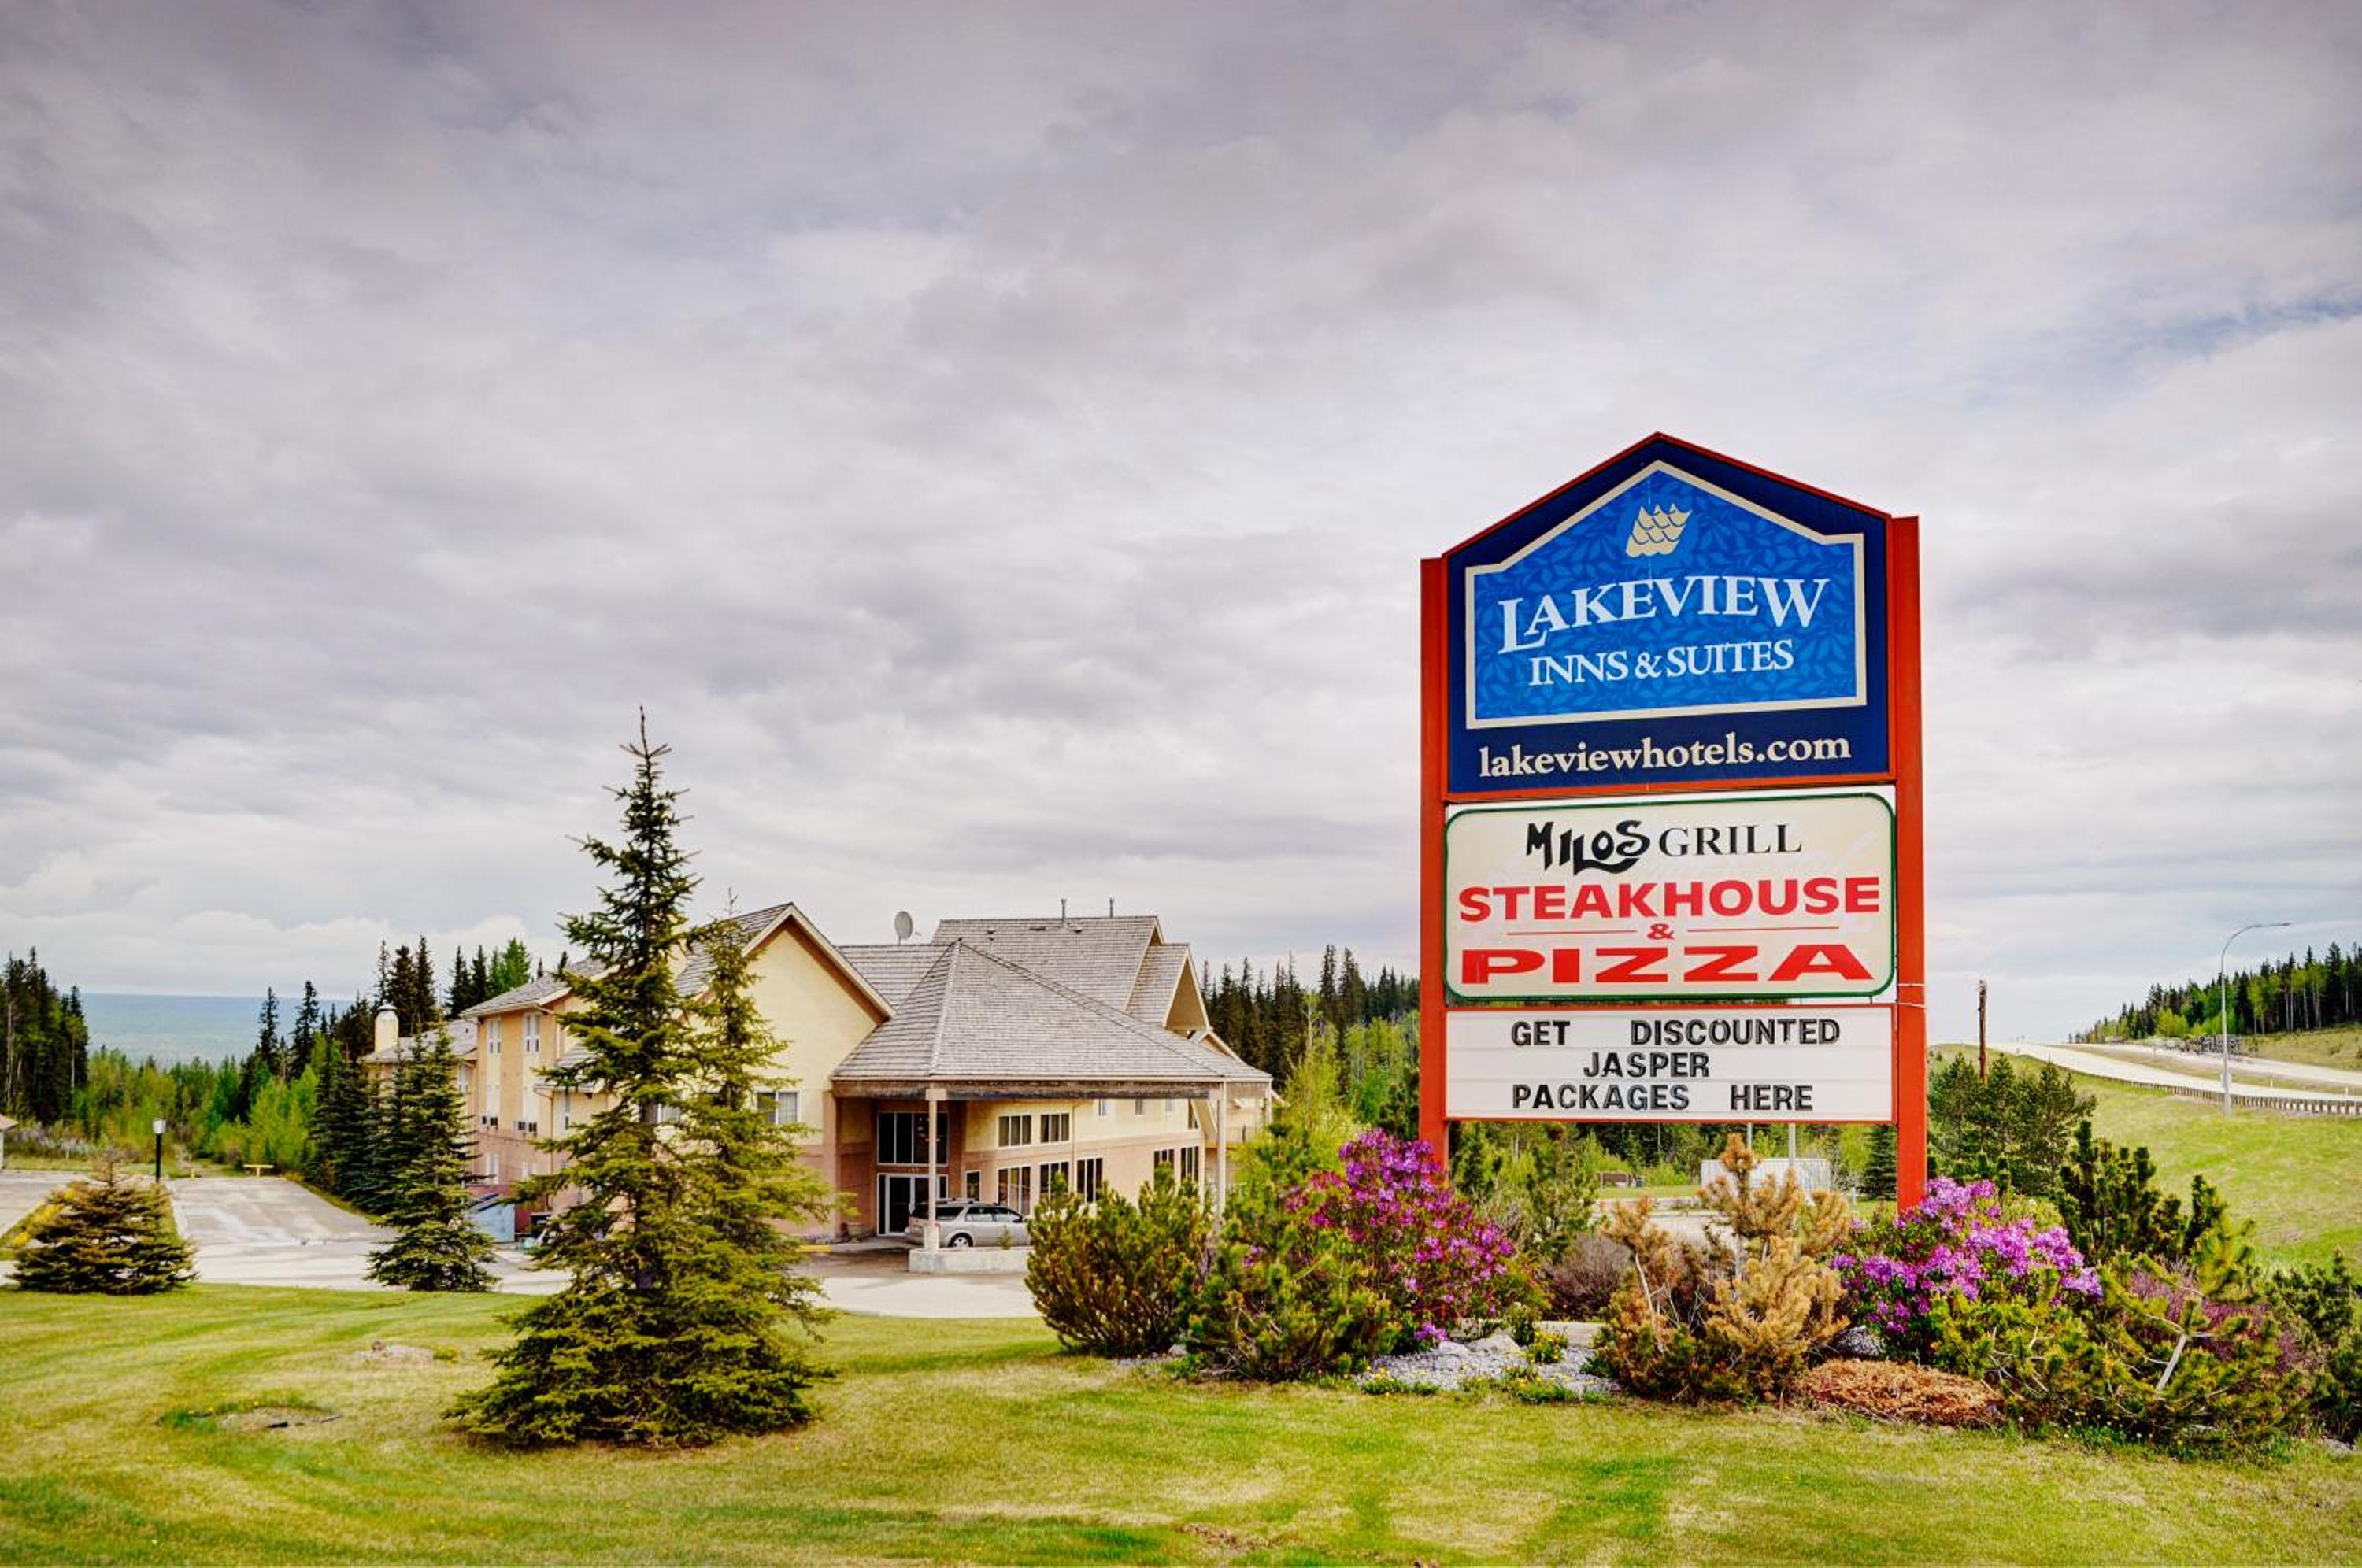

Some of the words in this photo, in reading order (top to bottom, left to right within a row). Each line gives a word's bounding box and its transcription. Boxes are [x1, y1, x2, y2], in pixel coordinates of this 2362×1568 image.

[1498, 575, 1829, 654] LAKEVIEW
[1529, 650, 1628, 686] INNS
[1634, 653, 1666, 679] &
[1665, 638, 1794, 678] SUITES
[1479, 732, 1851, 778] lakeviewhotels.com
[1526, 819, 1651, 876] MILOS
[1659, 823, 1802, 857] GRILL
[1459, 877, 1879, 922] STEAKHOUSE
[1646, 923, 1675, 941] &
[1461, 945, 1874, 984] PIZZA
[1511, 1019, 1571, 1046] GET
[1631, 1019, 1840, 1045] DISCOUNTED
[1583, 1052, 1709, 1078] JASPER
[1512, 1084, 1689, 1111] PACKAGES
[1731, 1084, 1812, 1111] HERE
